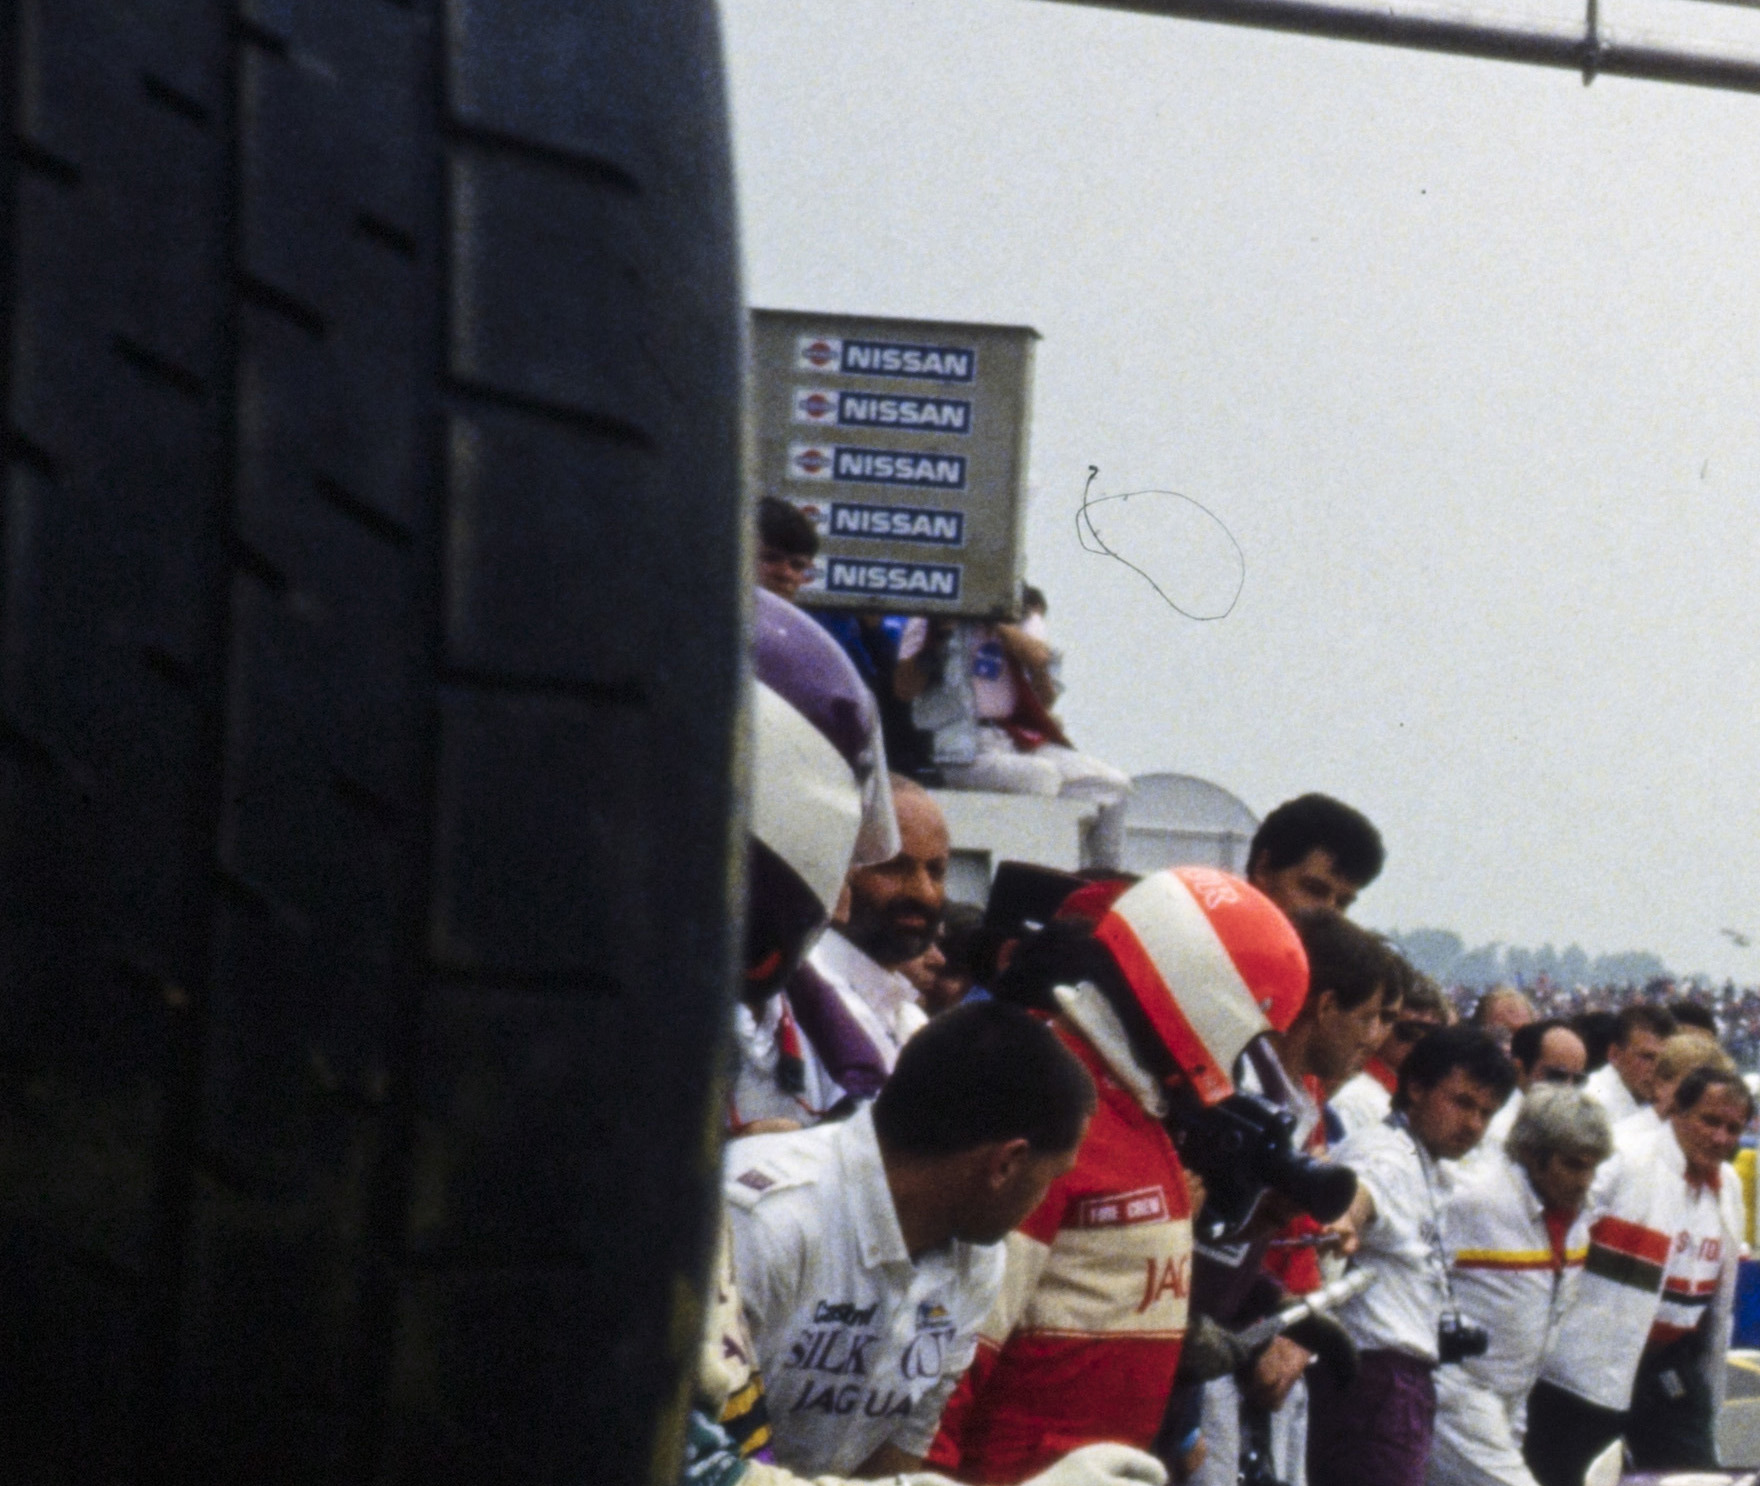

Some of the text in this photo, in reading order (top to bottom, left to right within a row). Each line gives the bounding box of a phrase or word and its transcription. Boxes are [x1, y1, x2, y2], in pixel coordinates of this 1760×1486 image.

[847, 345, 968, 377] NISSAN
[844, 397, 965, 428] NISSAN
[839, 452, 961, 483] NISSAN
[836, 508, 958, 539] NISSAN
[832, 563, 955, 594] NISSAN
